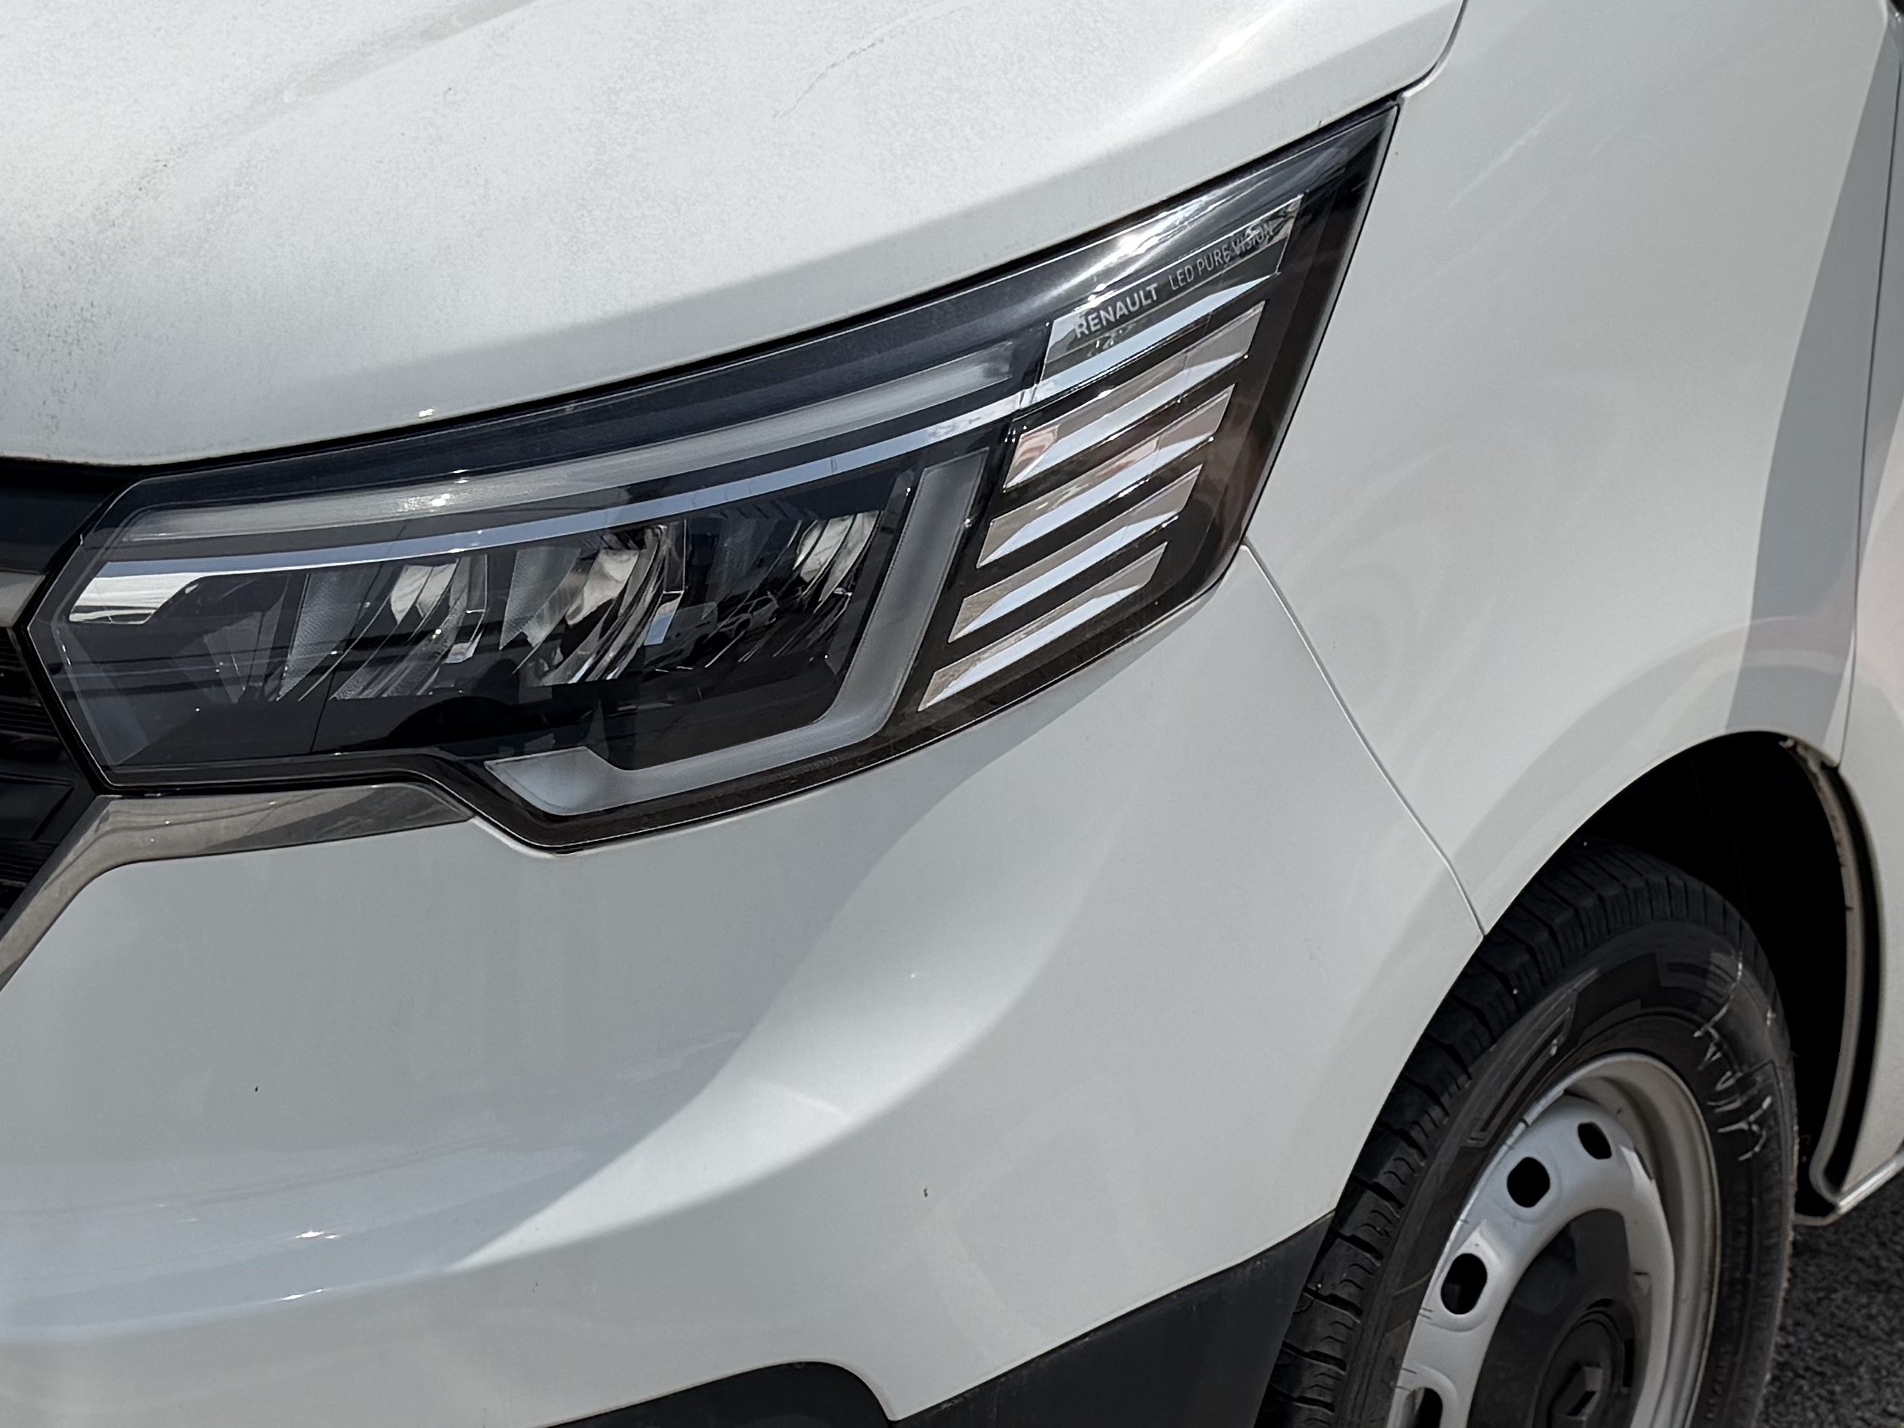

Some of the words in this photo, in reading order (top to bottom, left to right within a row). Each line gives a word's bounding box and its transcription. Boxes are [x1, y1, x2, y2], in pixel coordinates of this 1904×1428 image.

[1074, 282, 1159, 339] RENAULT
[1168, 264, 1195, 291] LED
[1196, 246, 1230, 276] PURE
